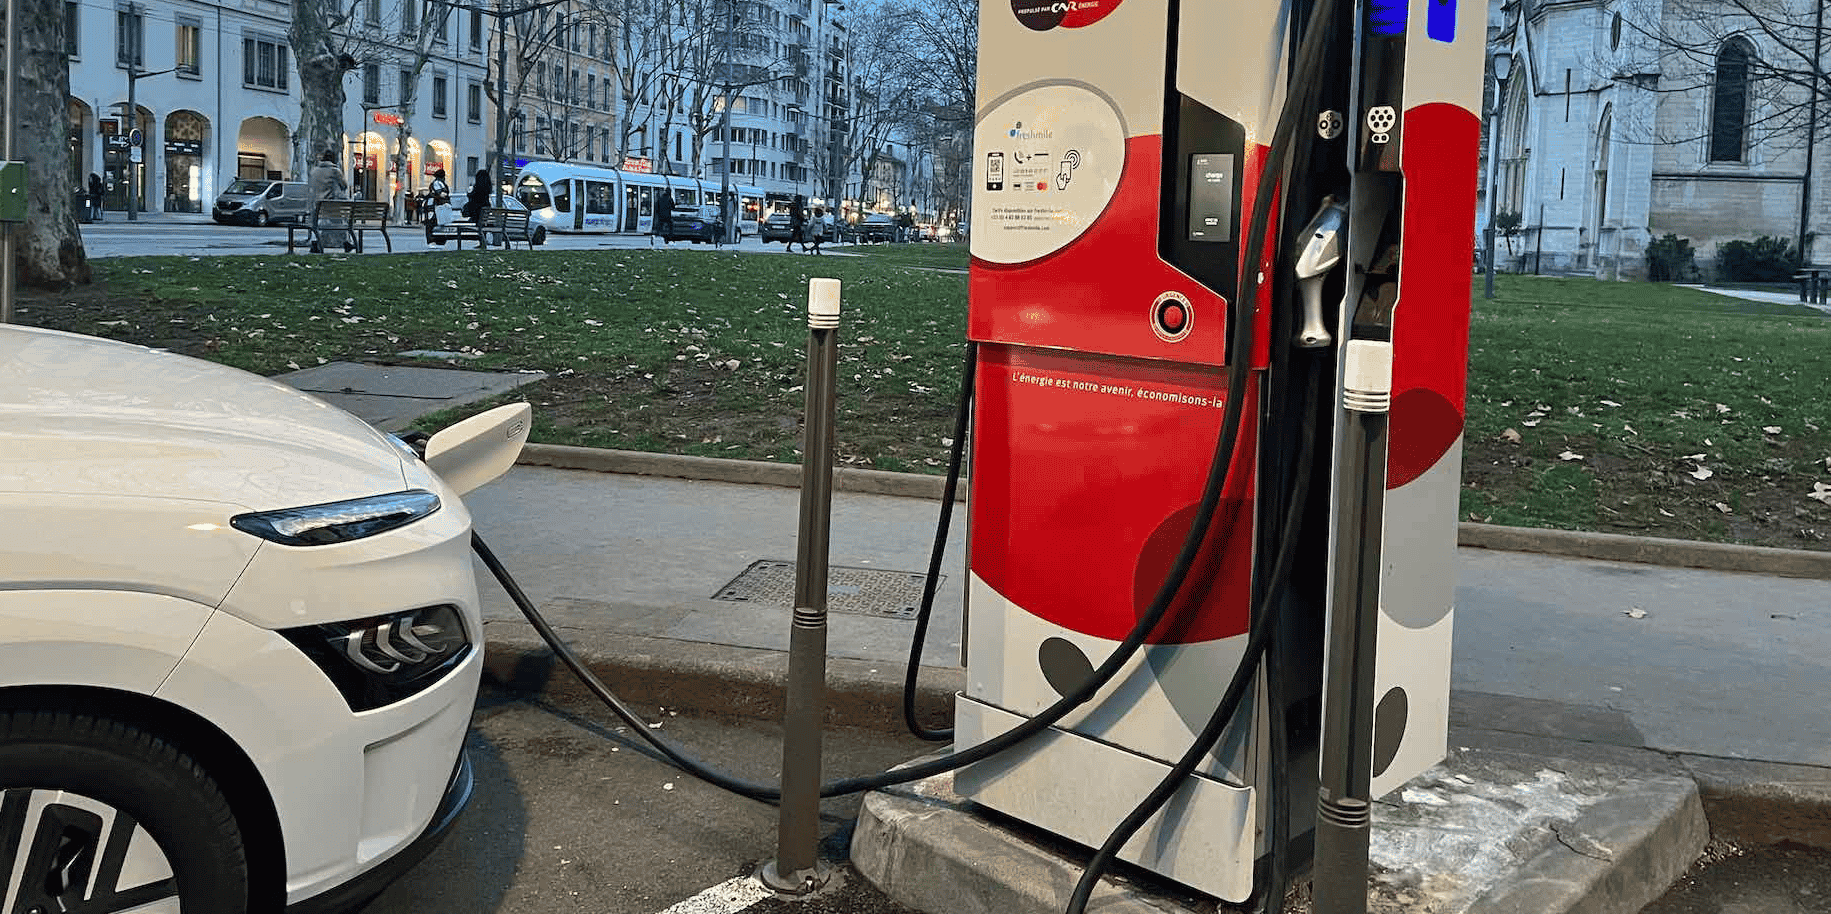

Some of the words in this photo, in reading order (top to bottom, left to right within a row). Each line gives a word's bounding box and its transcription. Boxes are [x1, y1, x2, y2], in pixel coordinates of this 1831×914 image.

[1012, 372, 1053, 387] L'énergie
[1056, 379, 1071, 389] est
[1073, 380, 1099, 392] notre
[1100, 384, 1134, 398] avenir,
[1137, 388, 1223, 408] économisons-la
